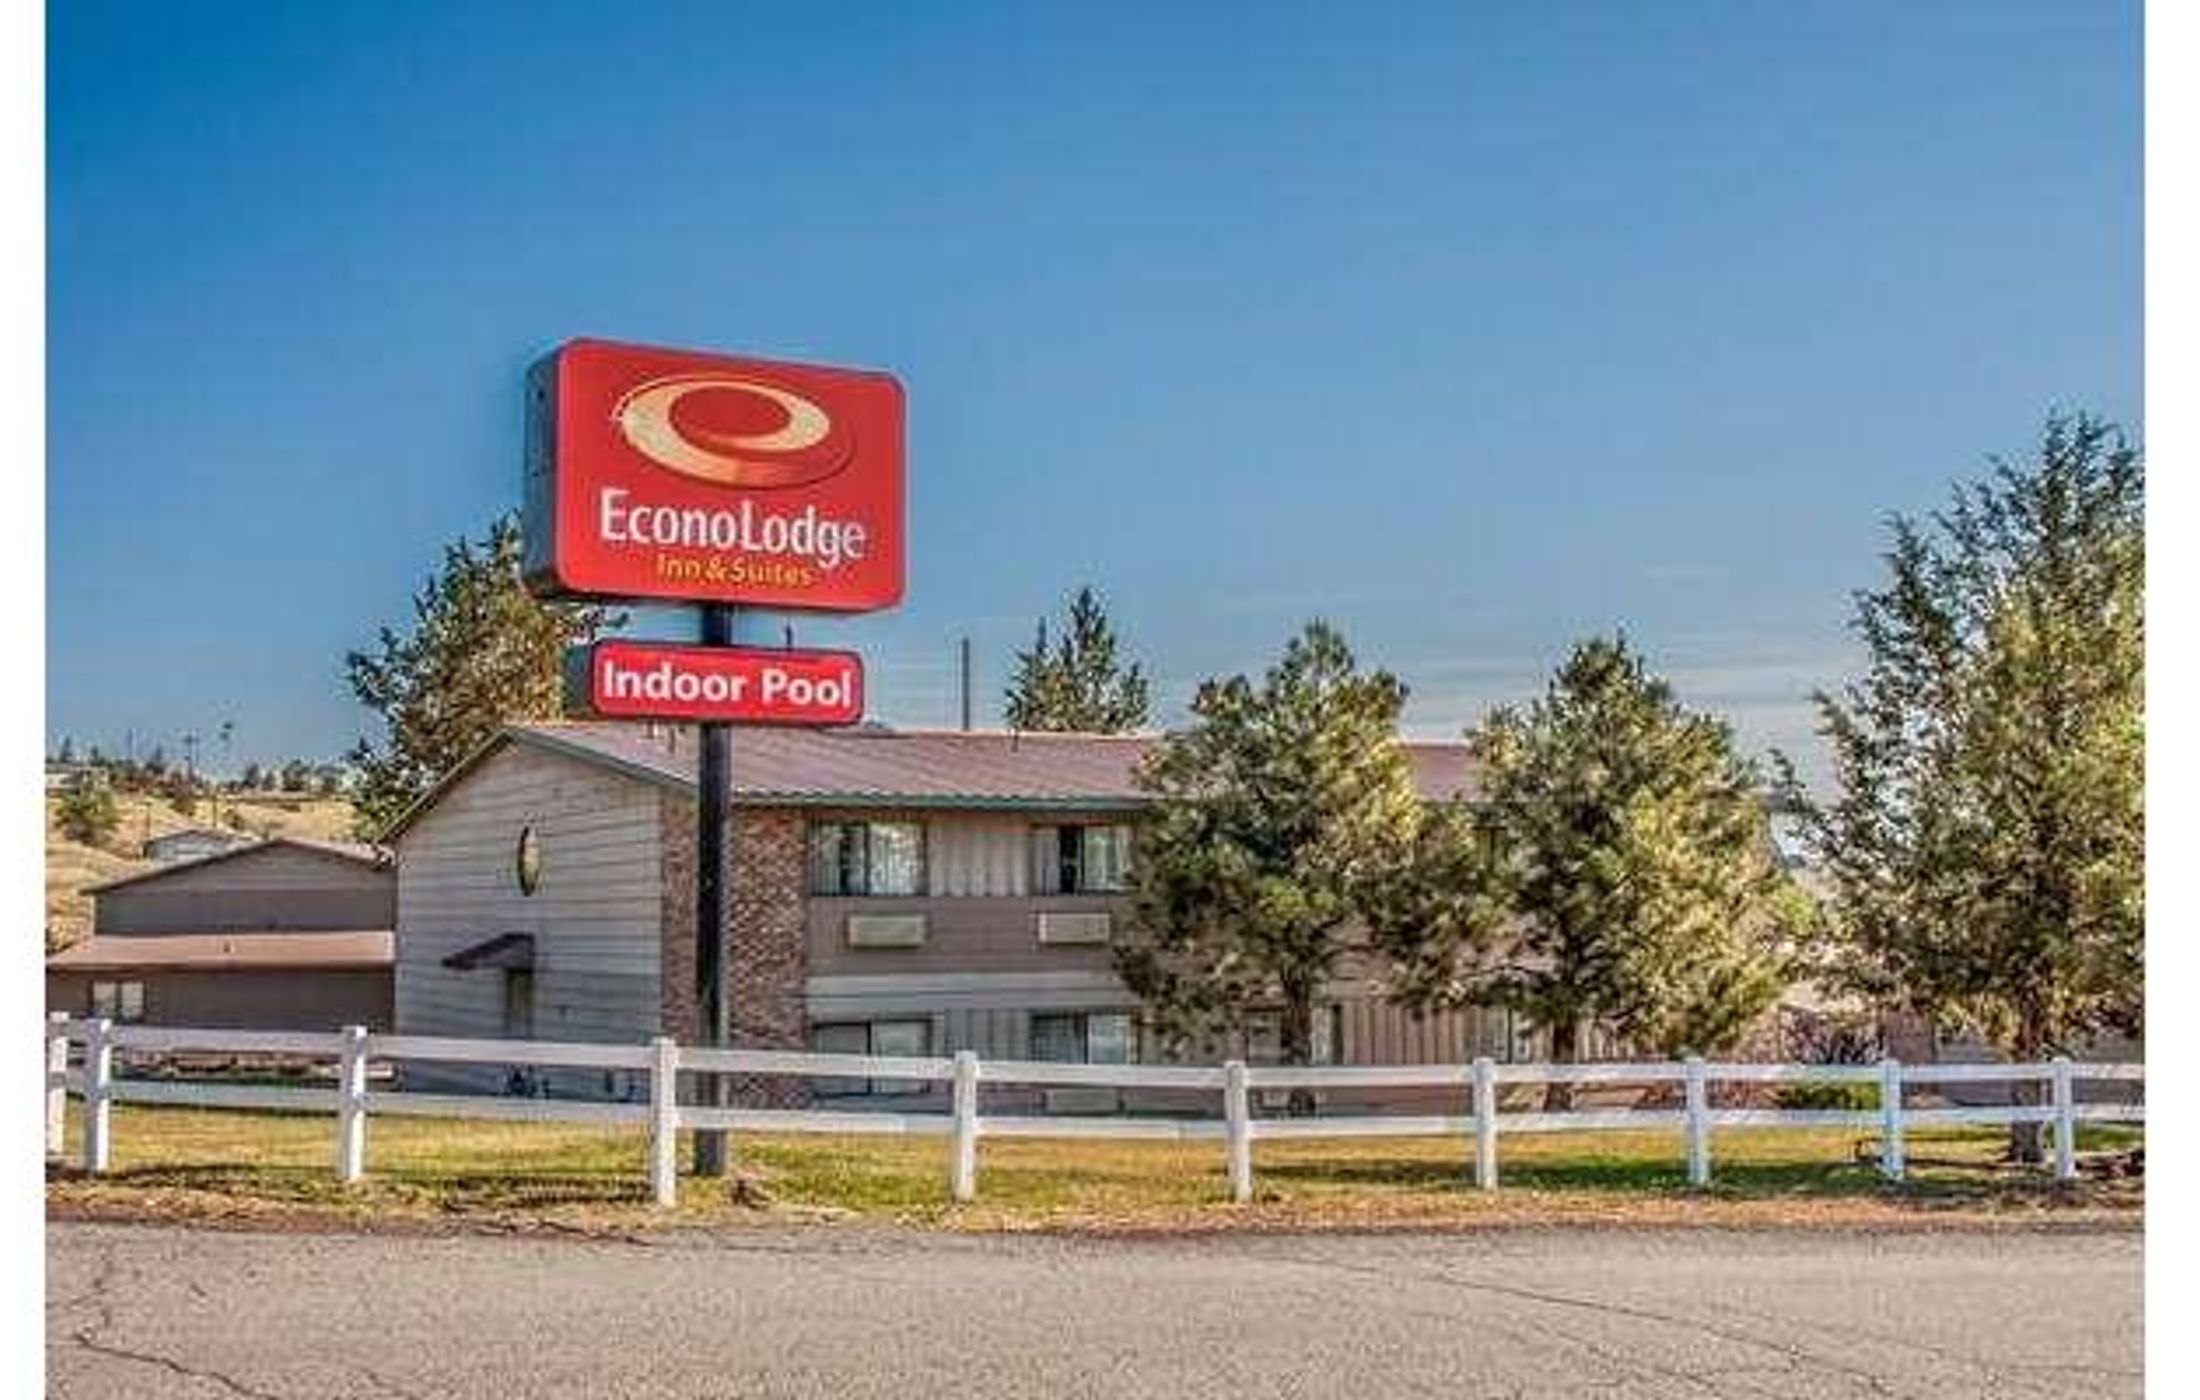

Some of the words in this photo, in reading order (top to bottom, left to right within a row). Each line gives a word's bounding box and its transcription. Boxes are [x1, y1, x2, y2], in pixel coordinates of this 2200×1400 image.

[657, 553, 701, 580] Inn
[603, 660, 748, 703] Indoor
[762, 669, 851, 706] Pool
